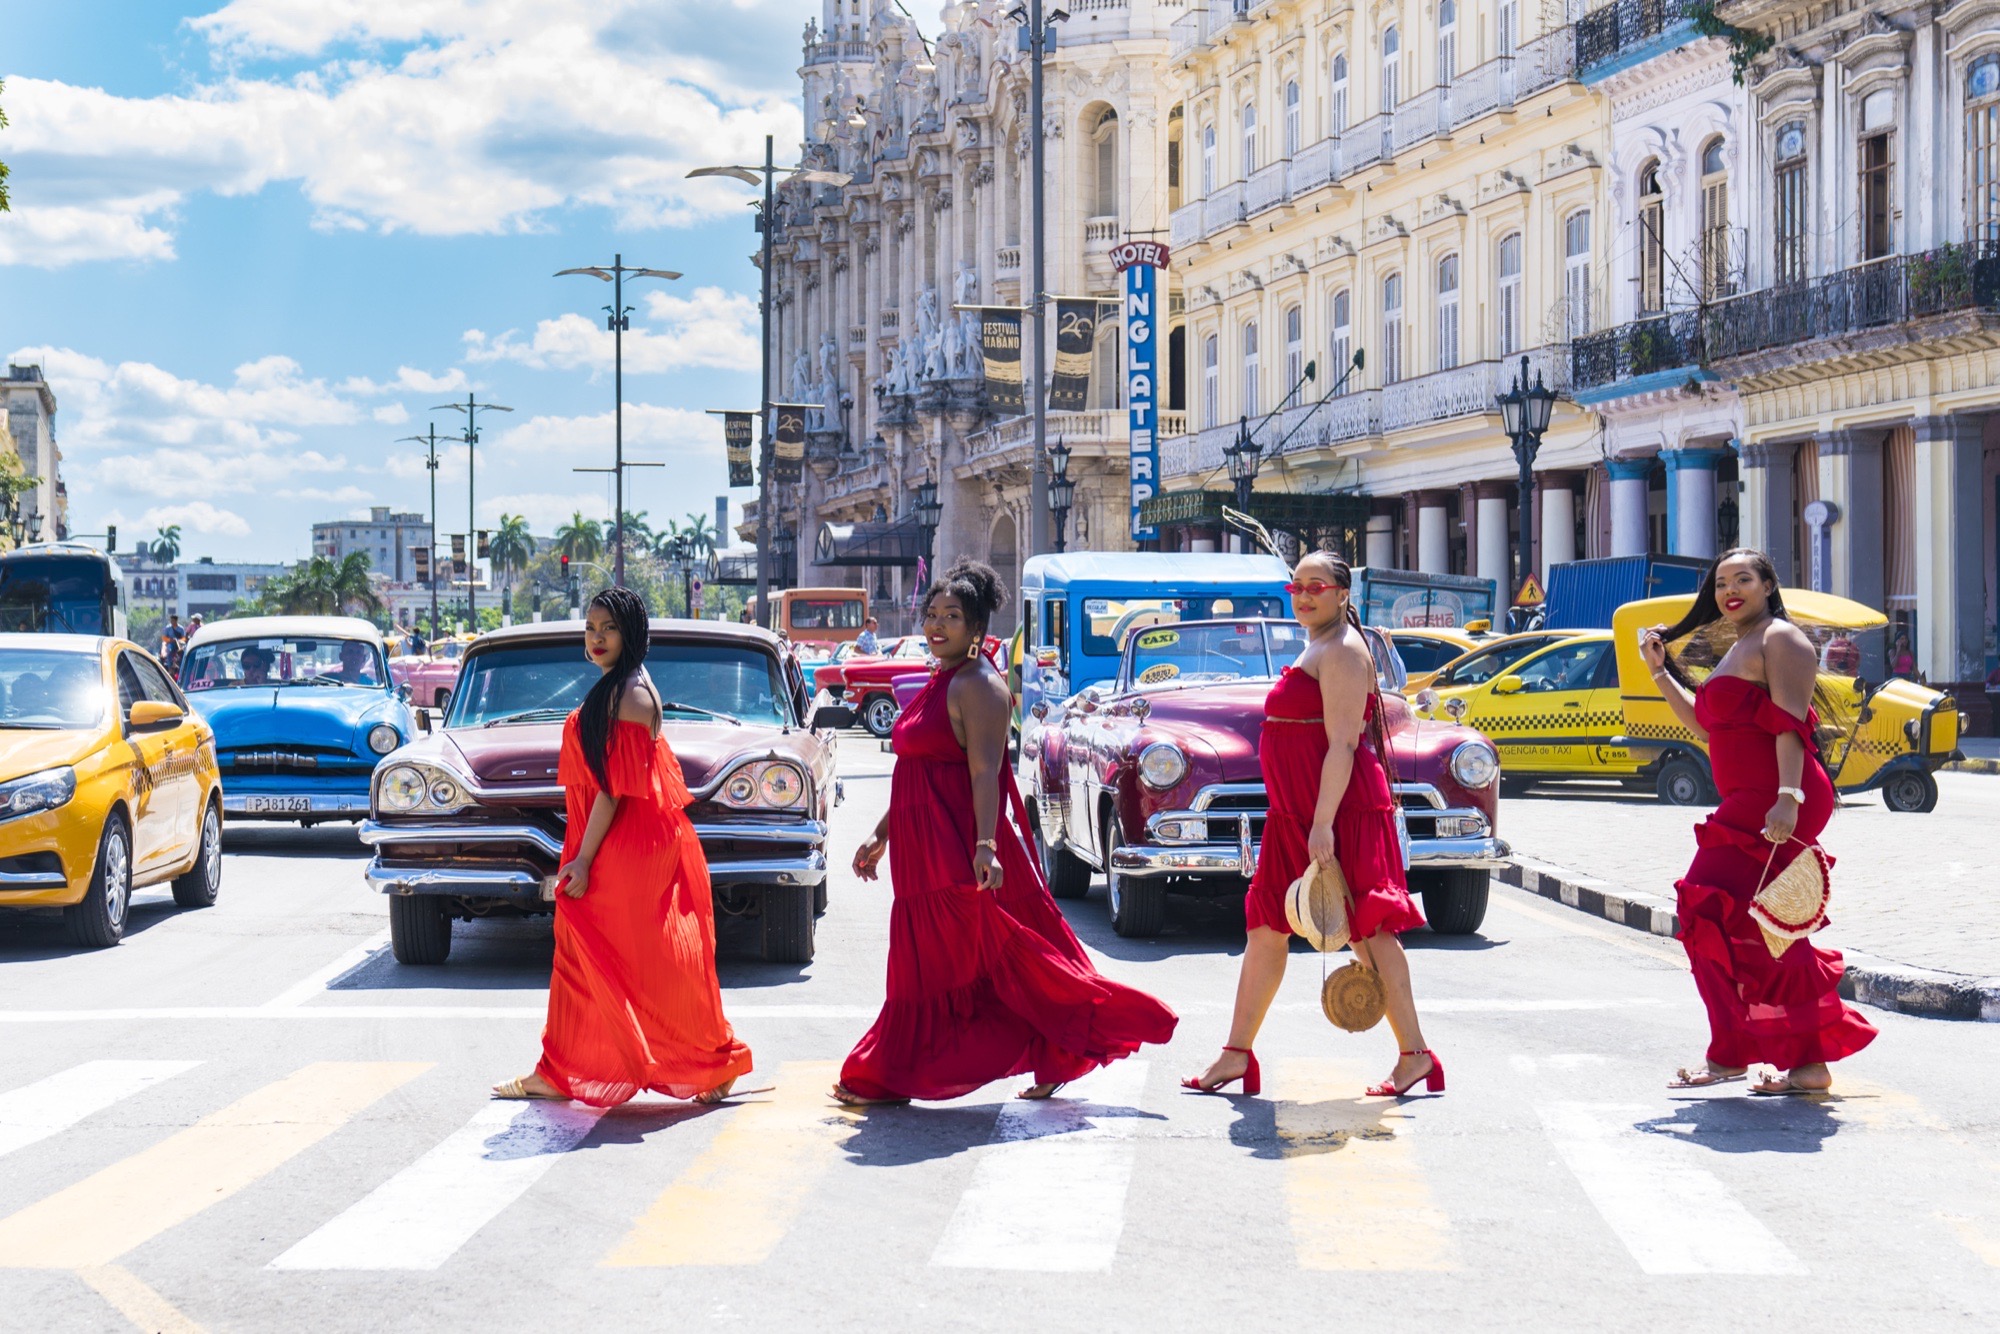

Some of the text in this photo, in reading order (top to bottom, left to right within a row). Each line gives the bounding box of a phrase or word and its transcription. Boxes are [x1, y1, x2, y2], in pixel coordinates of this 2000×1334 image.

[1110, 243, 1162, 268] HOTEL
[983, 322, 1019, 335] FESTIVAL
[984, 336, 1020, 349] HABANO
[1403, 612, 1455, 628] Nestlé
[1142, 633, 1175, 645] TAXI
[190, 680, 212, 689] TAXI
[1499, 746, 1572, 755] AGENCIA de TAXI
